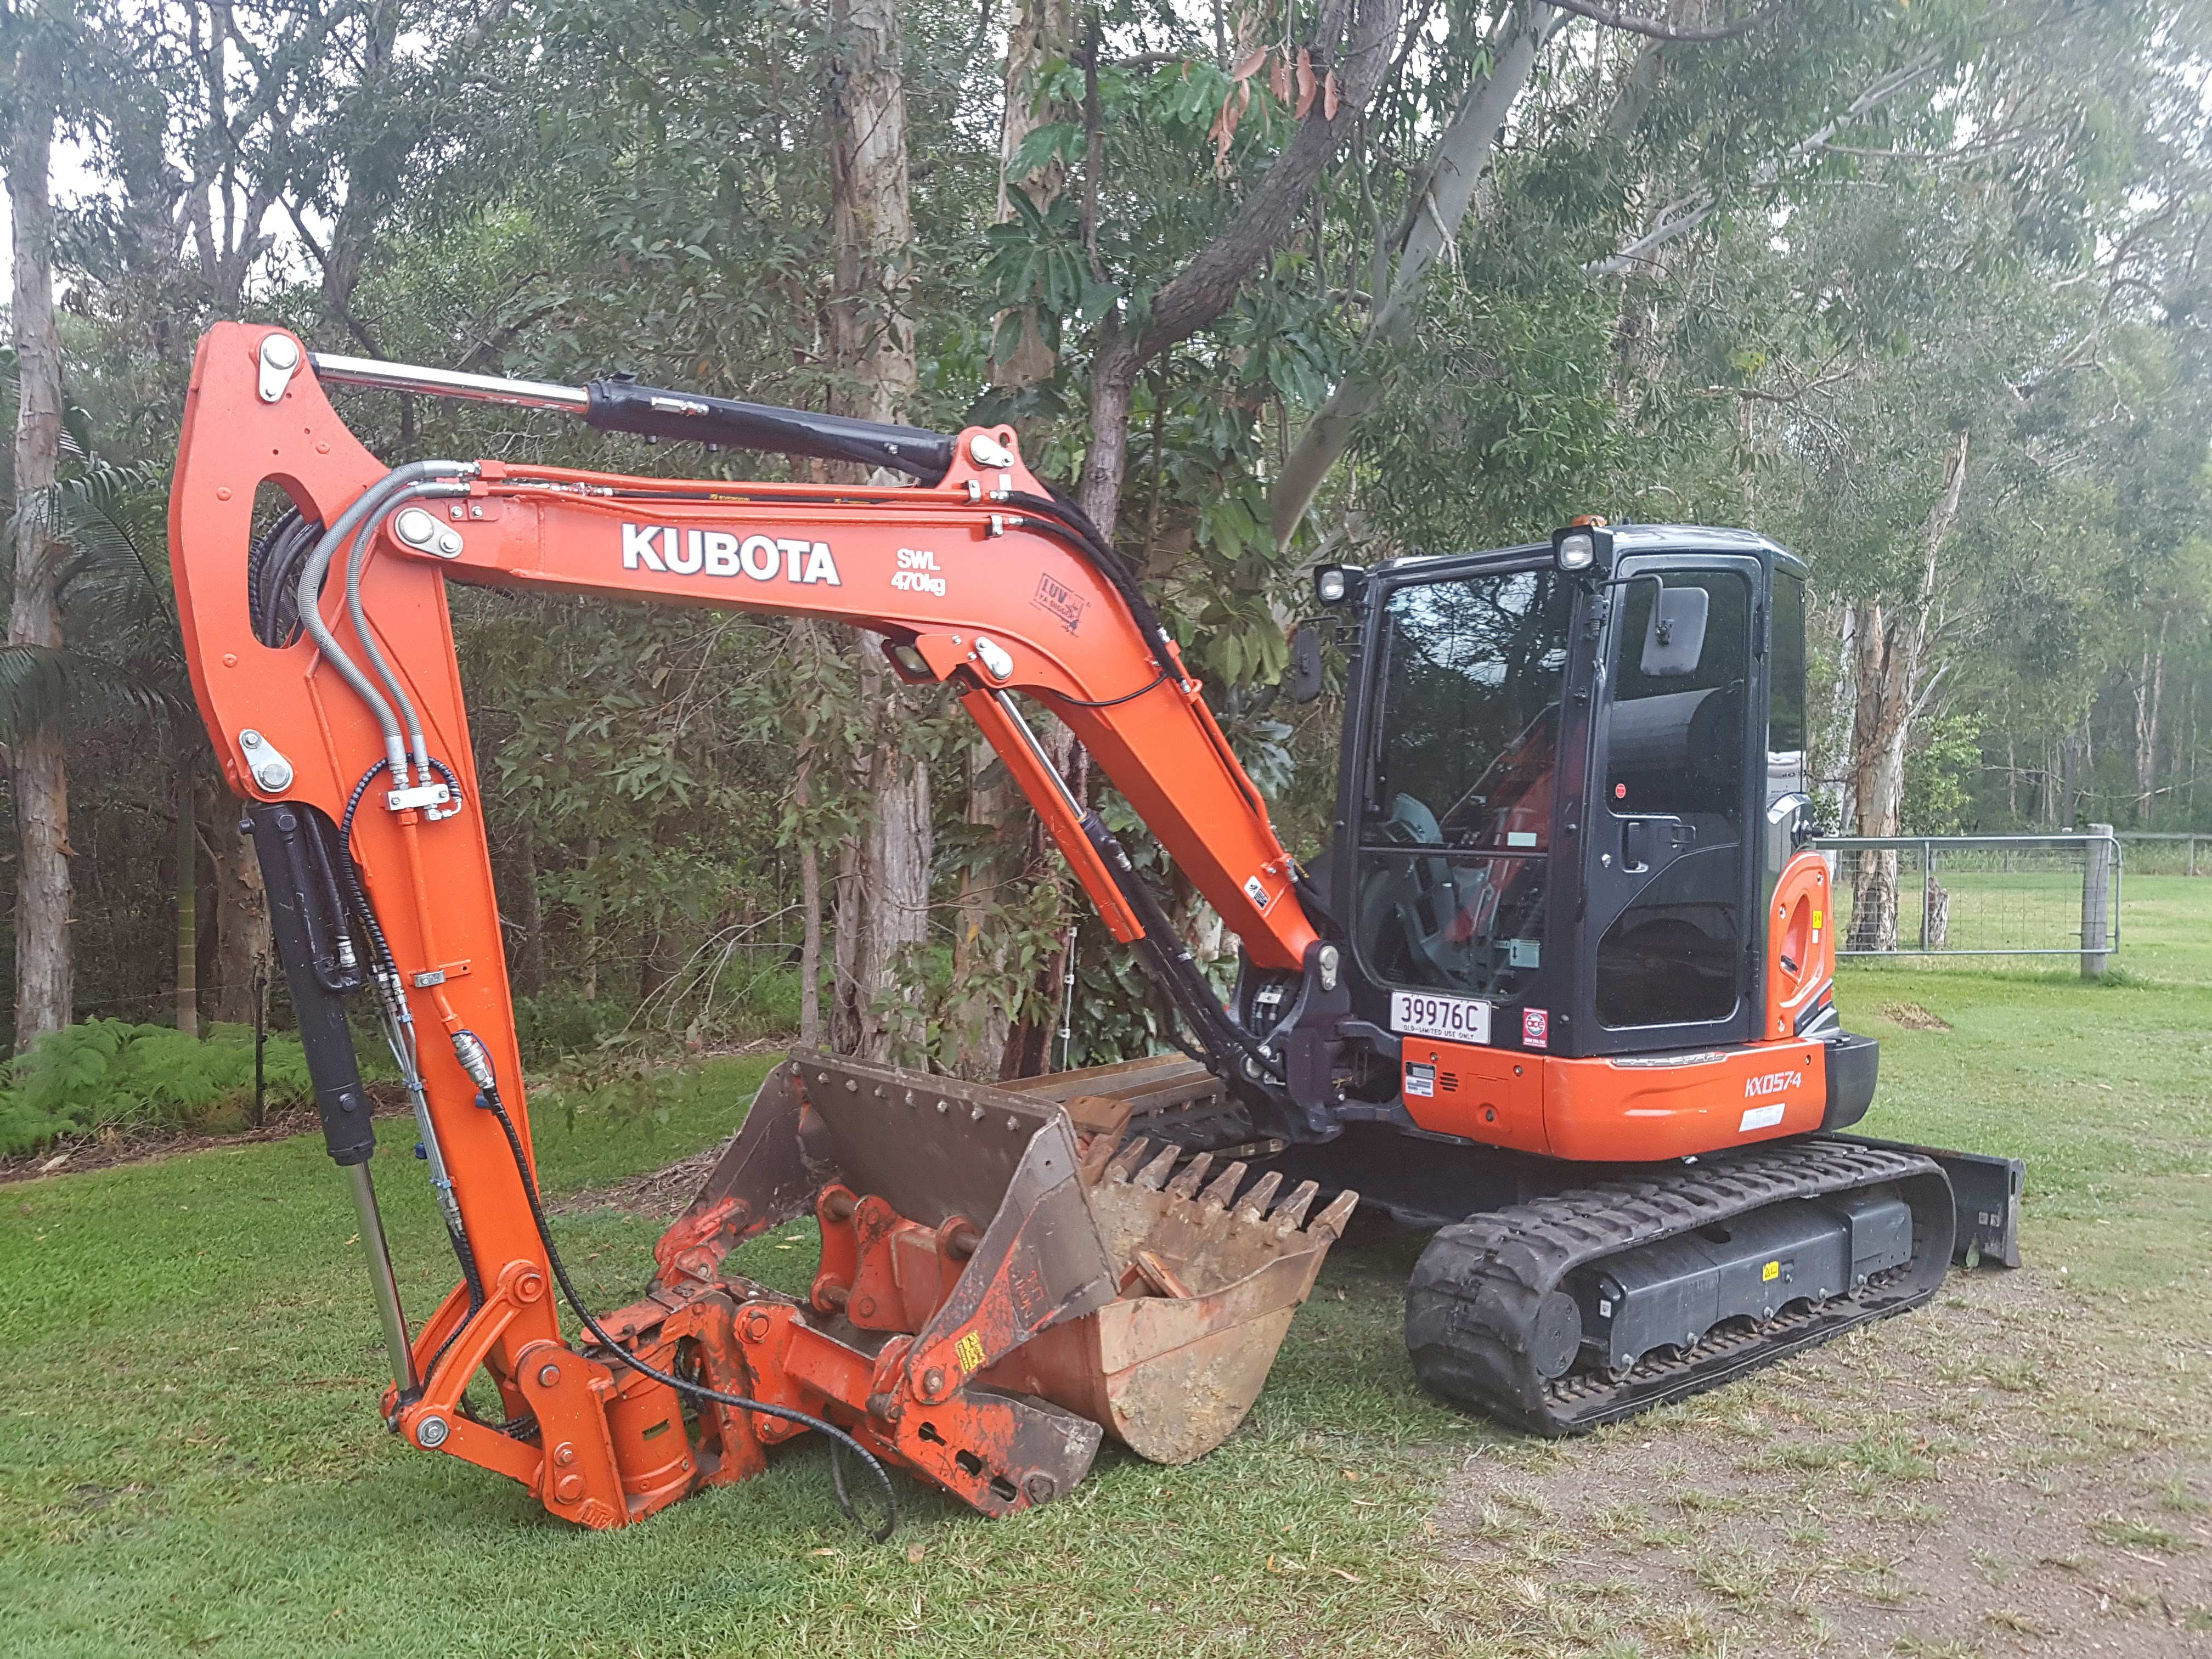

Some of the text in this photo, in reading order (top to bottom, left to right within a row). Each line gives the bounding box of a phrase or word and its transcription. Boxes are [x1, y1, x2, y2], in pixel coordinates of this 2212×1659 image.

[622, 523, 842, 586] KUBOTA
[896, 548, 941, 571] SWL
[891, 571, 946, 597] 470kg
[1042, 578, 1068, 603] LUV
[1401, 997, 1479, 1032] 39976C
[1526, 1020, 1545, 1029] ace
[1459, 1031, 1475, 1040] ONLY
